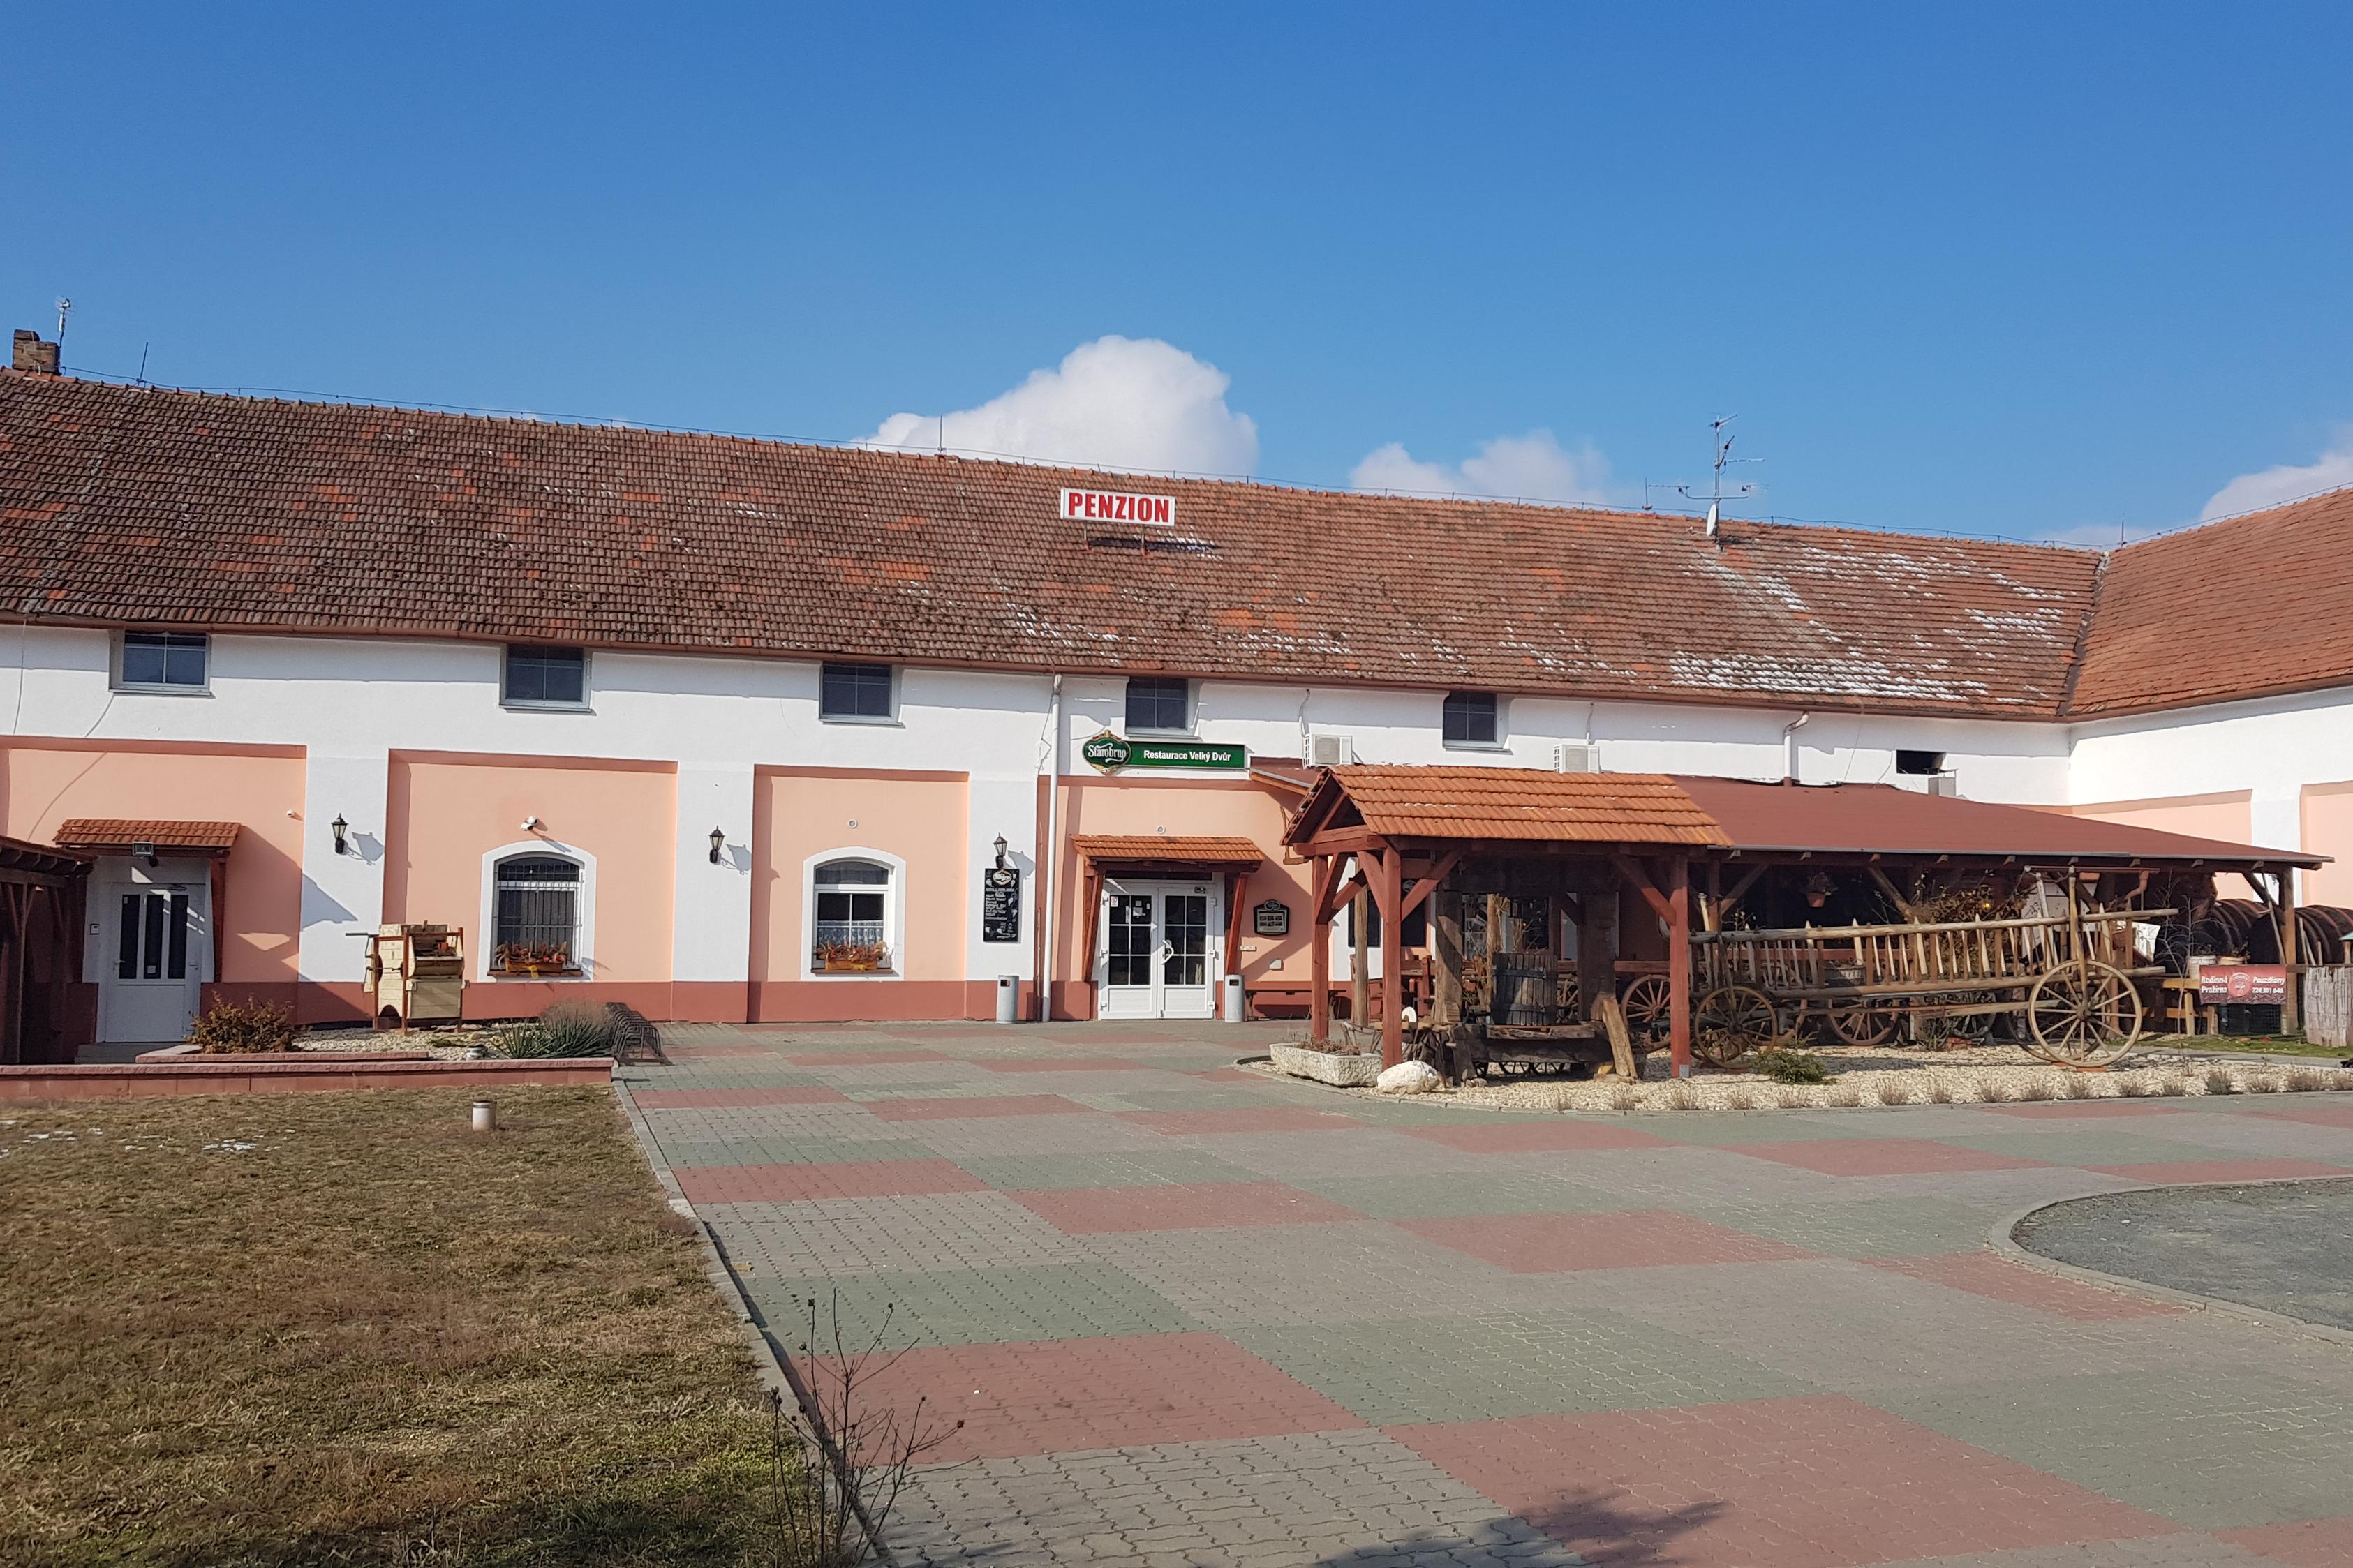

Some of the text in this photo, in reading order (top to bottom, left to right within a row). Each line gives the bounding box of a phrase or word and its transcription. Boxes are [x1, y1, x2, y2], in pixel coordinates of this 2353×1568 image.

[1068, 492, 1169, 523] PENZION
[1088, 743, 1127, 762] Starobrno
[1143, 749, 1231, 763] Restaurace Velký Dvůr
